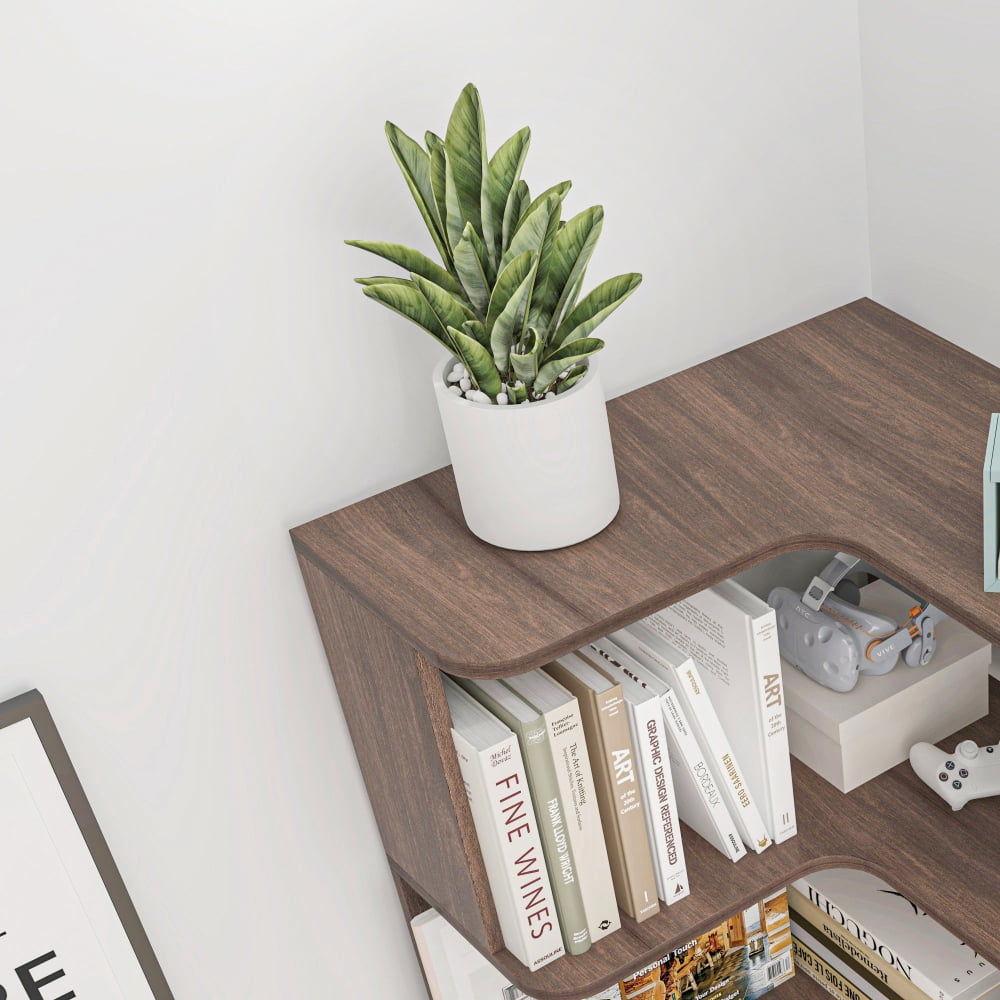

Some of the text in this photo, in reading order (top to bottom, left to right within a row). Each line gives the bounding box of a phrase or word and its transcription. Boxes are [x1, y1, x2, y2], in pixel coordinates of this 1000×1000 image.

[763, 673, 782, 708] ART
[569, 742, 578, 757] The
[647, 719, 662, 766] GRAPHIC
[572, 758, 581, 771] Art
[611, 748, 635, 785] ART
[653, 765, 668, 803] DESIGN
[694, 761, 720, 808] BORDEAUX
[721, 753, 751, 809] EERO SAARINEN
[577, 777, 588, 807] Knitting
[546, 797, 575, 885] FRANK LLOYD WRIGHT
[660, 803, 678, 866] REFERENCED
[496, 773, 553, 939] FINE WINES
[808, 885, 913, 982] NOGUCHI
[633, 939, 698, 981] Personal Touch
[814, 959, 824, 976] LE
[822, 923, 889, 985] Remodelista
[709, 977, 730, 995] Design
[826, 969, 843, 992] FOIS
